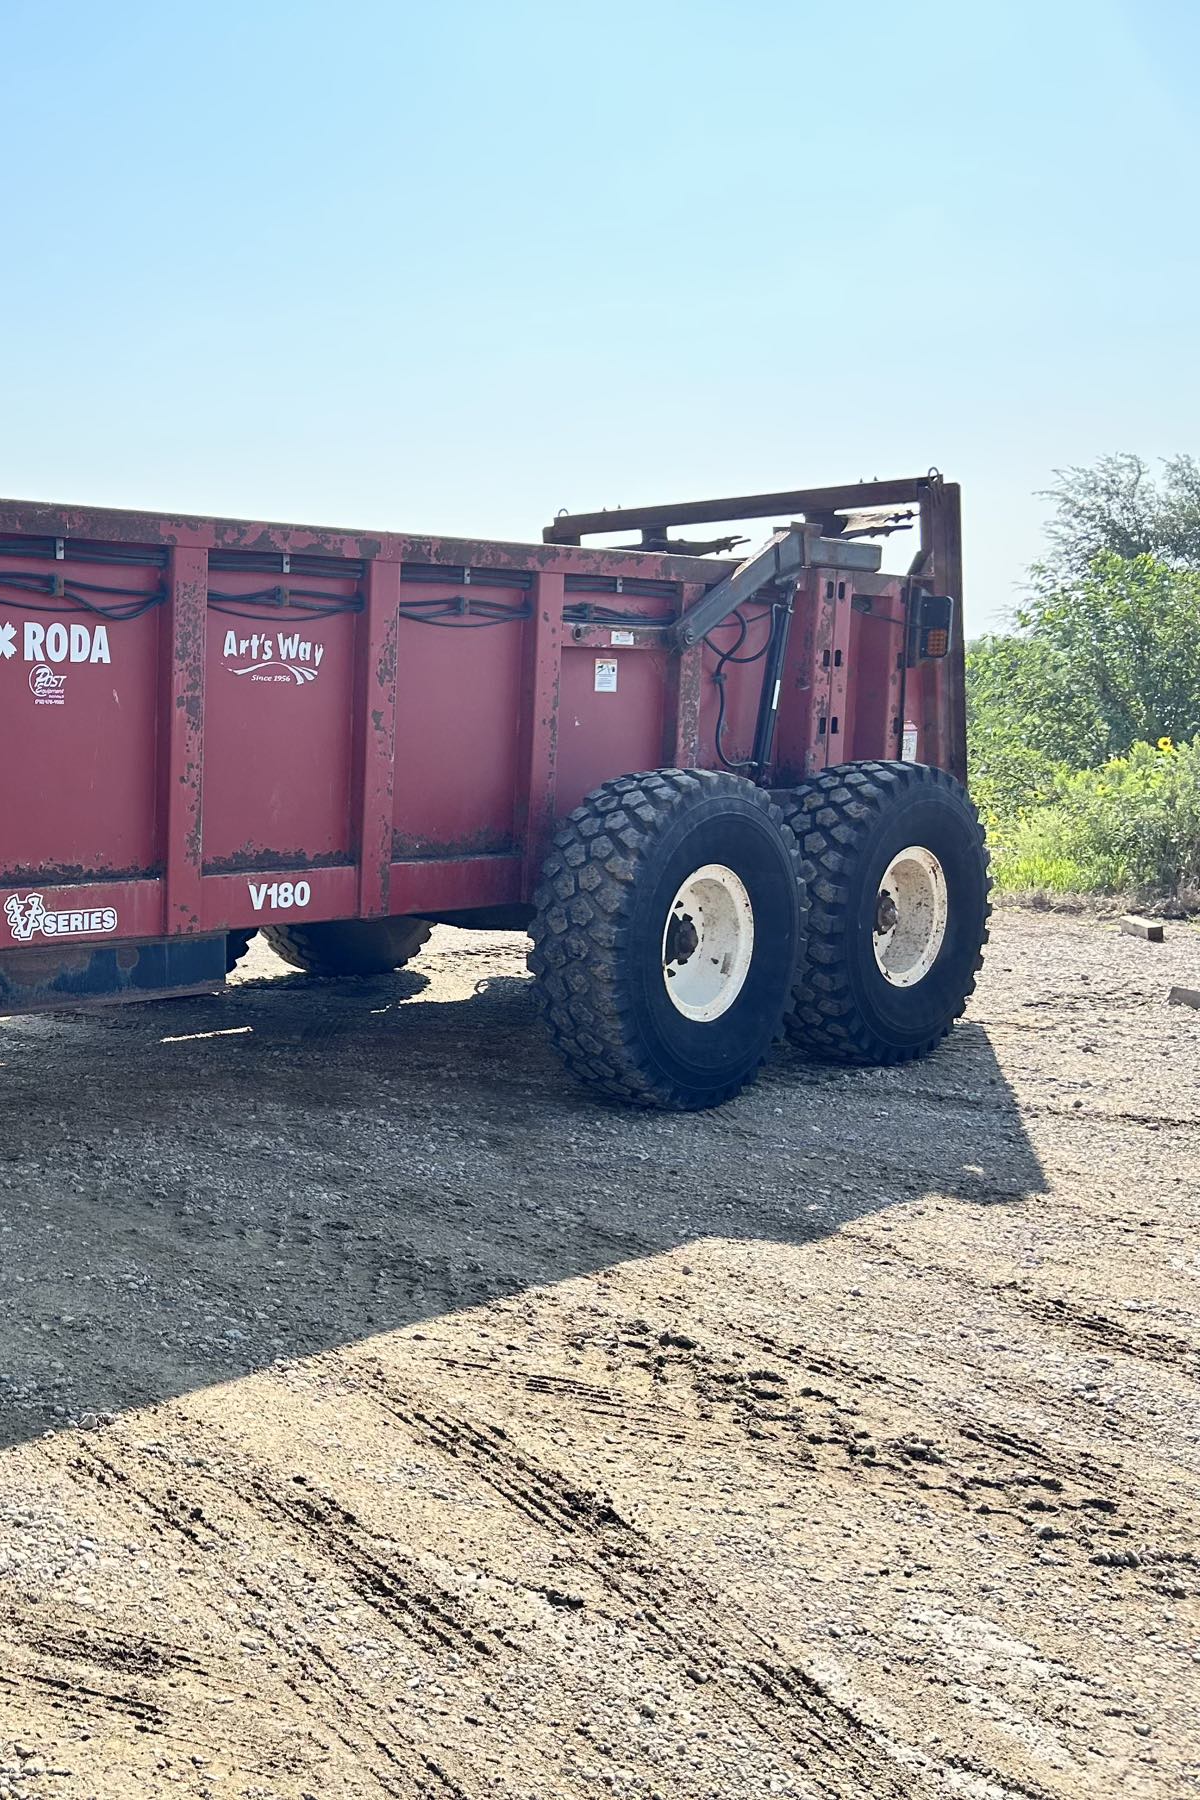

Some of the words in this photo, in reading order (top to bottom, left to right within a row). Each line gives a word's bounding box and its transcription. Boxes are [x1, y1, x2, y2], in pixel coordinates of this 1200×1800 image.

[24, 621, 111, 664] RODA
[223, 630, 273, 661] Art's
[277, 632, 324, 667] Way
[251, 674, 272, 682] Since
[248, 881, 311, 911] V180
[43, 908, 116, 935] SERIES
